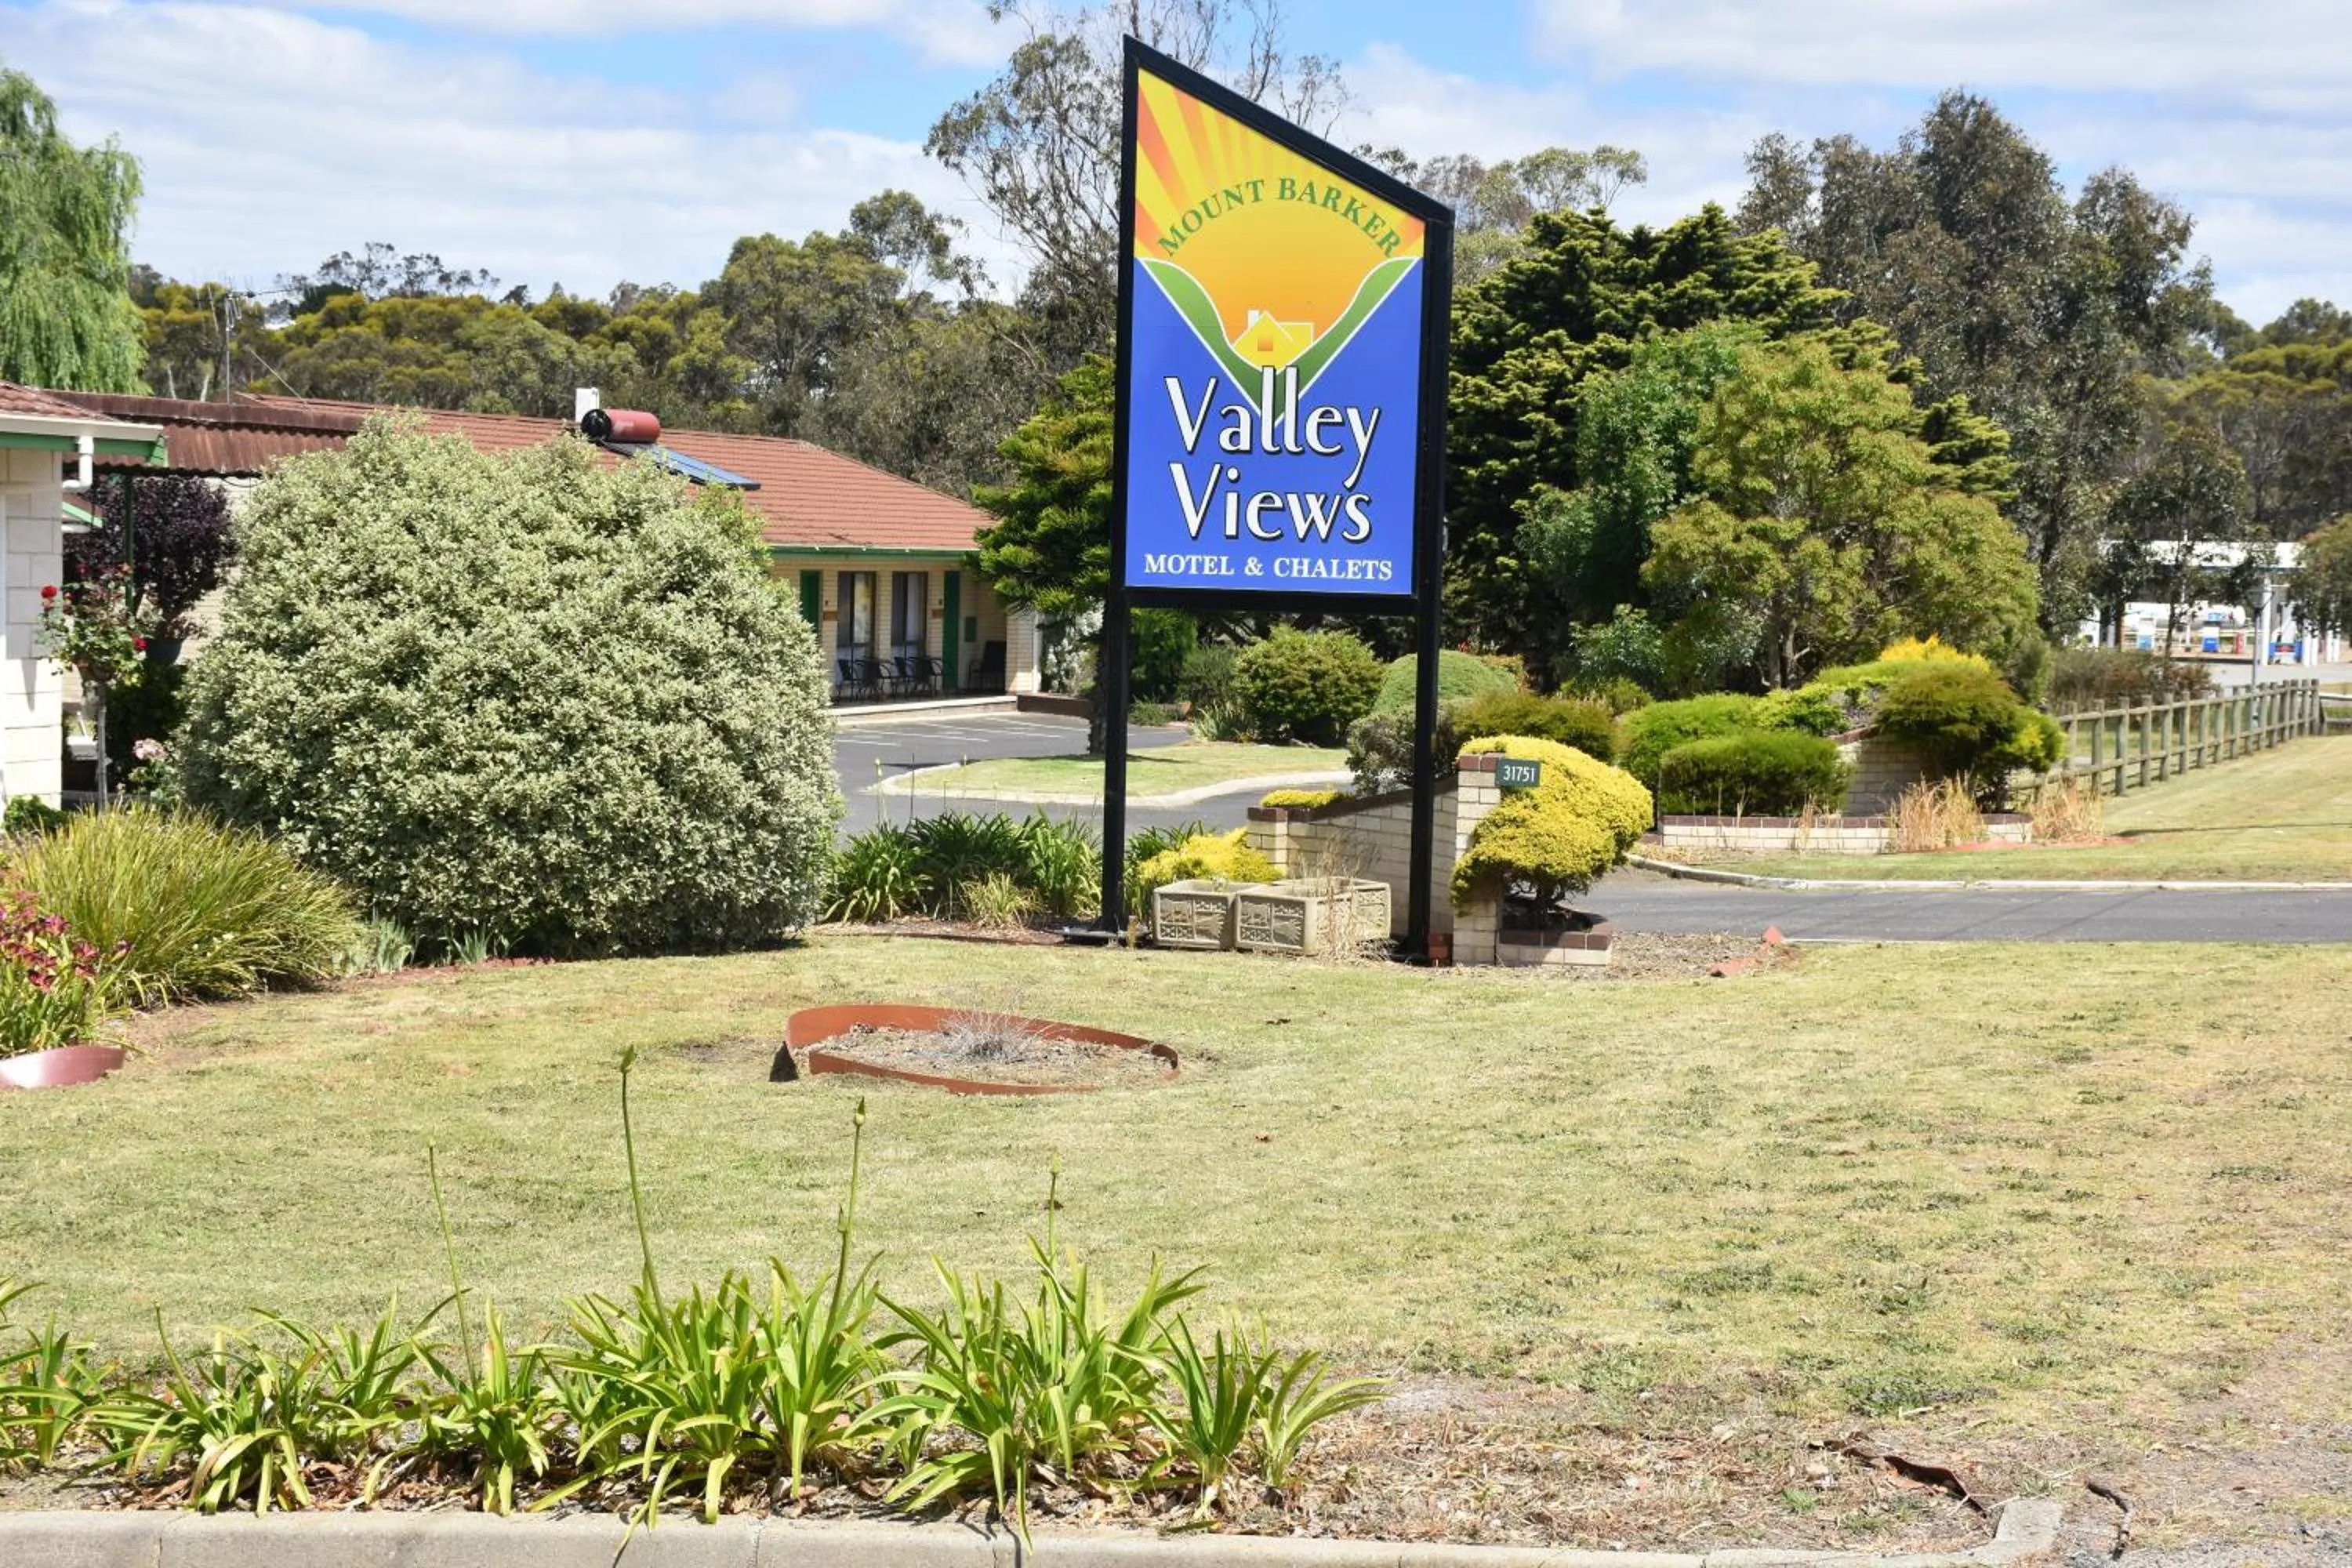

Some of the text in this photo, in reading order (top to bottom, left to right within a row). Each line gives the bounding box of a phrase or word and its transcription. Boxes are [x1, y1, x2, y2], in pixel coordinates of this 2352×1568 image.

[1158, 178, 1401, 257] MOUNT BARKER
[1164, 365, 1381, 490] Valley
[1169, 462, 1372, 543] Views
[1144, 554, 1392, 580] MOTEL & CHALETS
[1503, 764, 1535, 782] 31751
